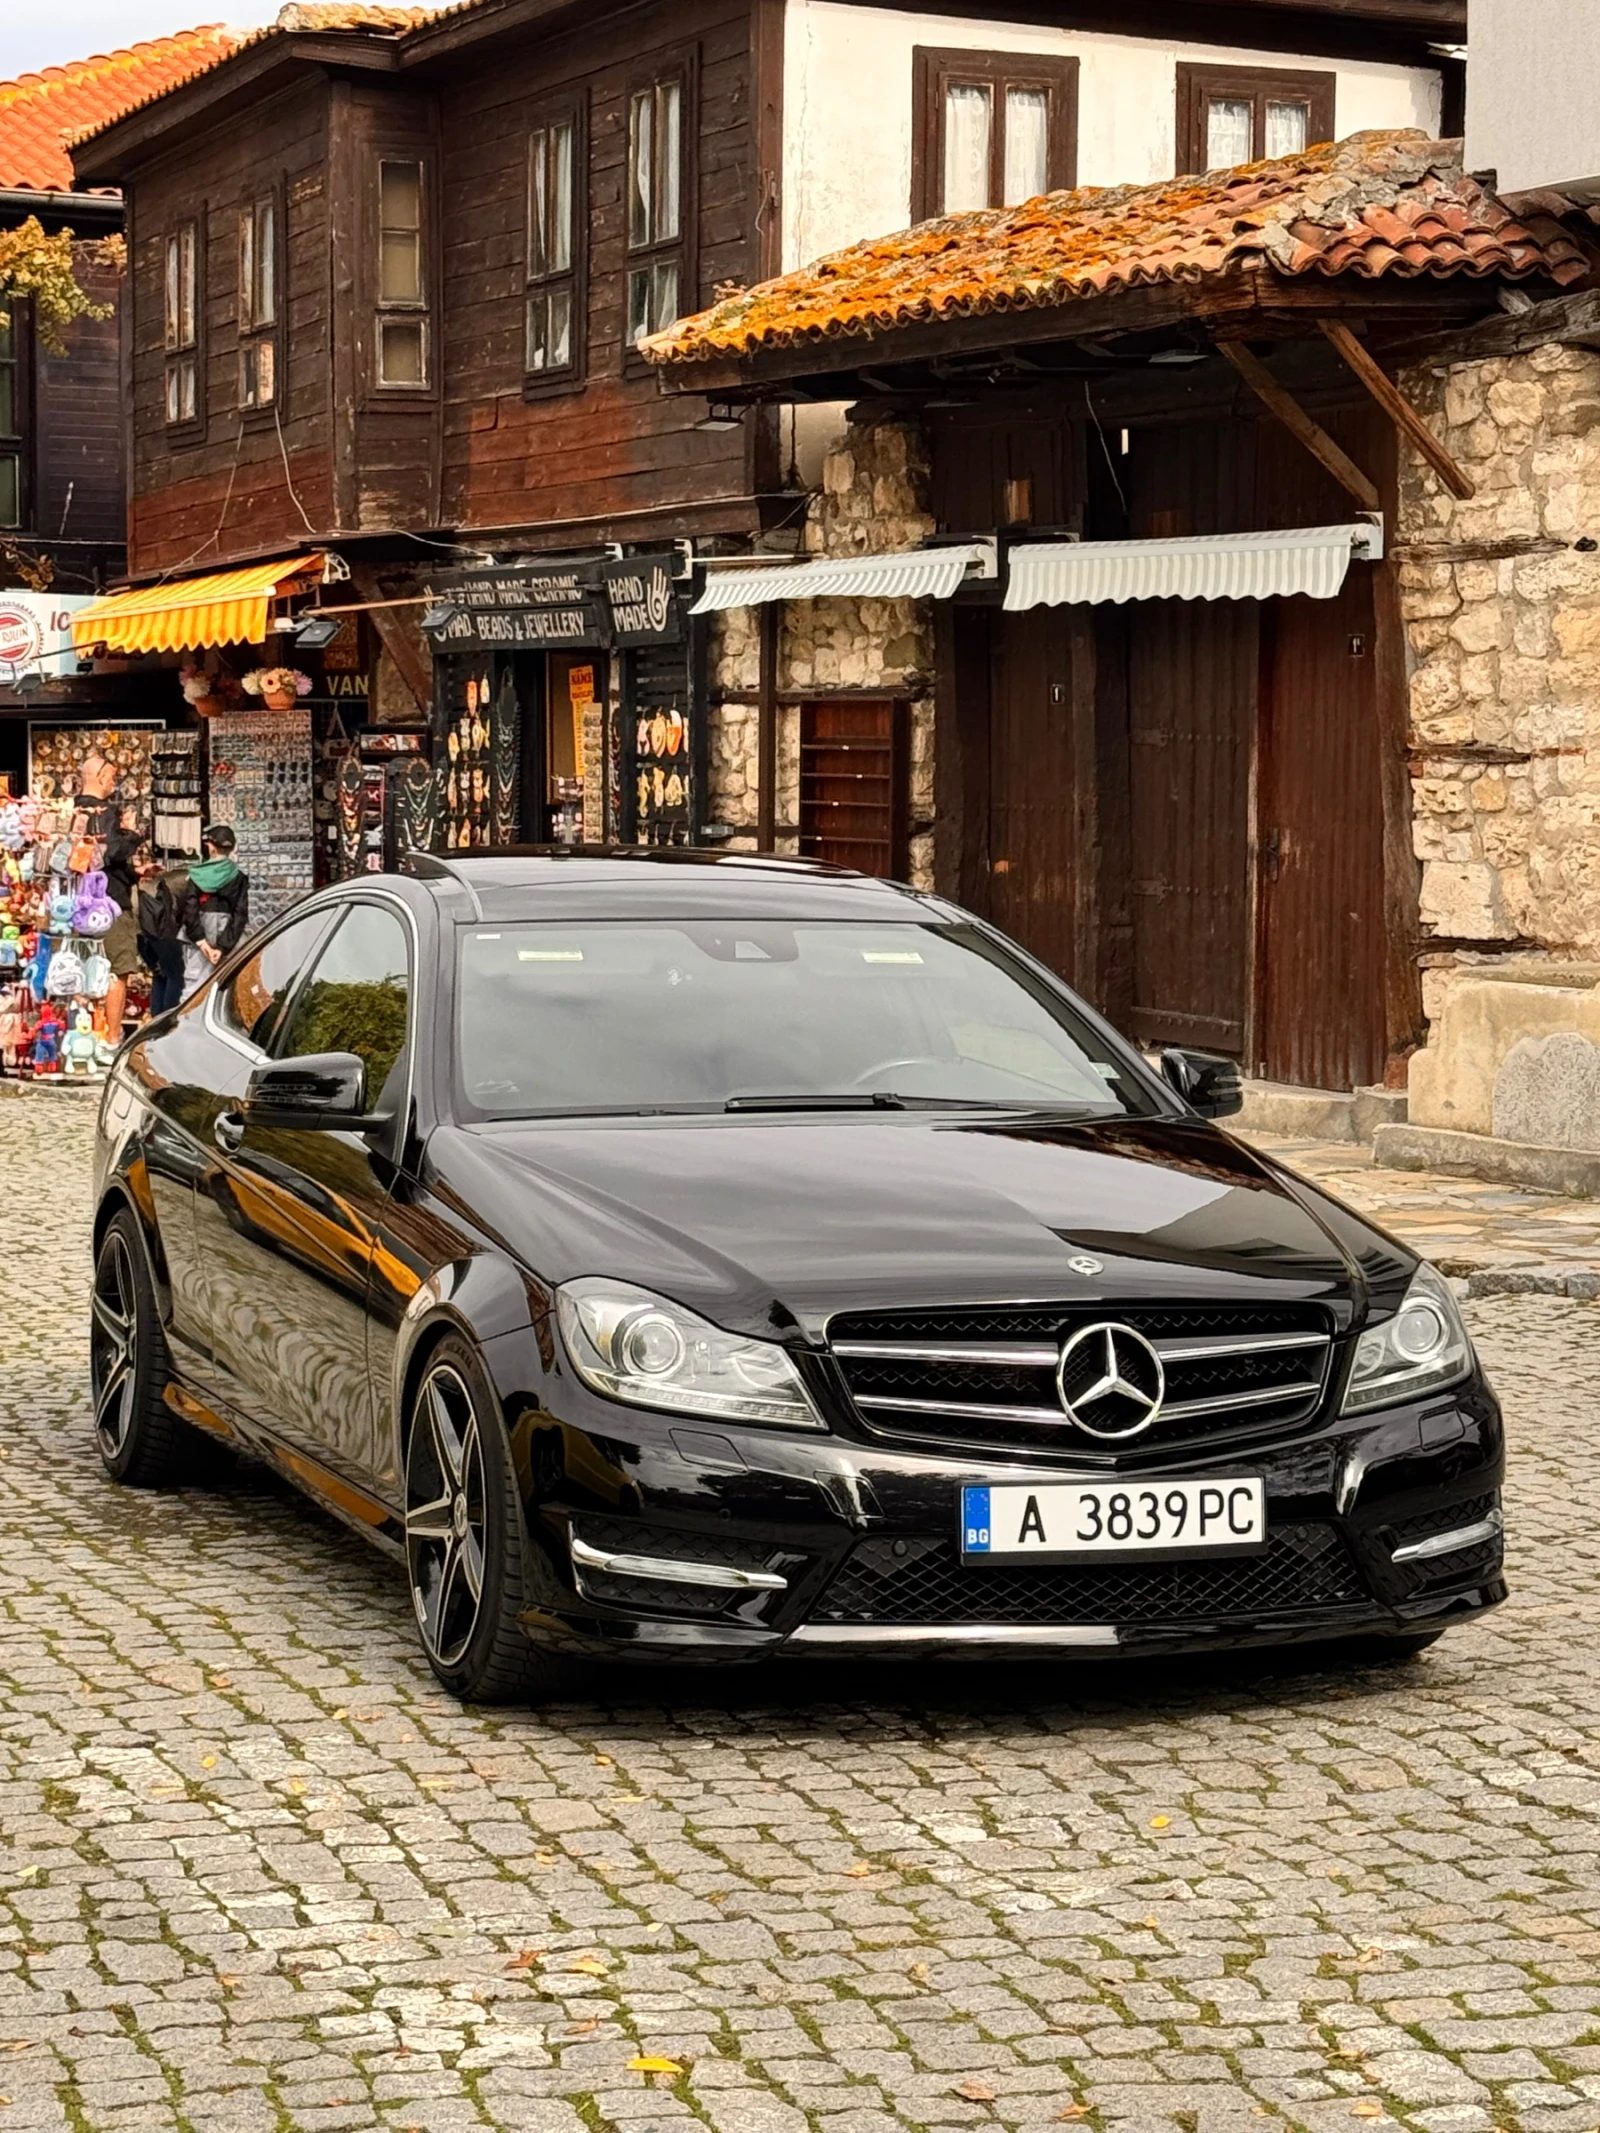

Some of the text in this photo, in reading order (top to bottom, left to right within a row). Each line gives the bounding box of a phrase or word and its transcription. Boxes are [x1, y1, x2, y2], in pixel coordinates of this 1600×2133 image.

[464, 581, 496, 606] HAND
[496, 578, 530, 605] MADE
[531, 574, 583, 602] CERAMIC
[608, 576, 643, 605] HAND
[476, 613, 514, 641] BEADS
[515, 621, 524, 641] &
[523, 610, 585, 640] JEWELLERY
[613, 603, 651, 633] MADE
[326, 675, 369, 696] VAN
[1018, 1495, 1046, 1543] A
[967, 1529, 988, 1544] BG
